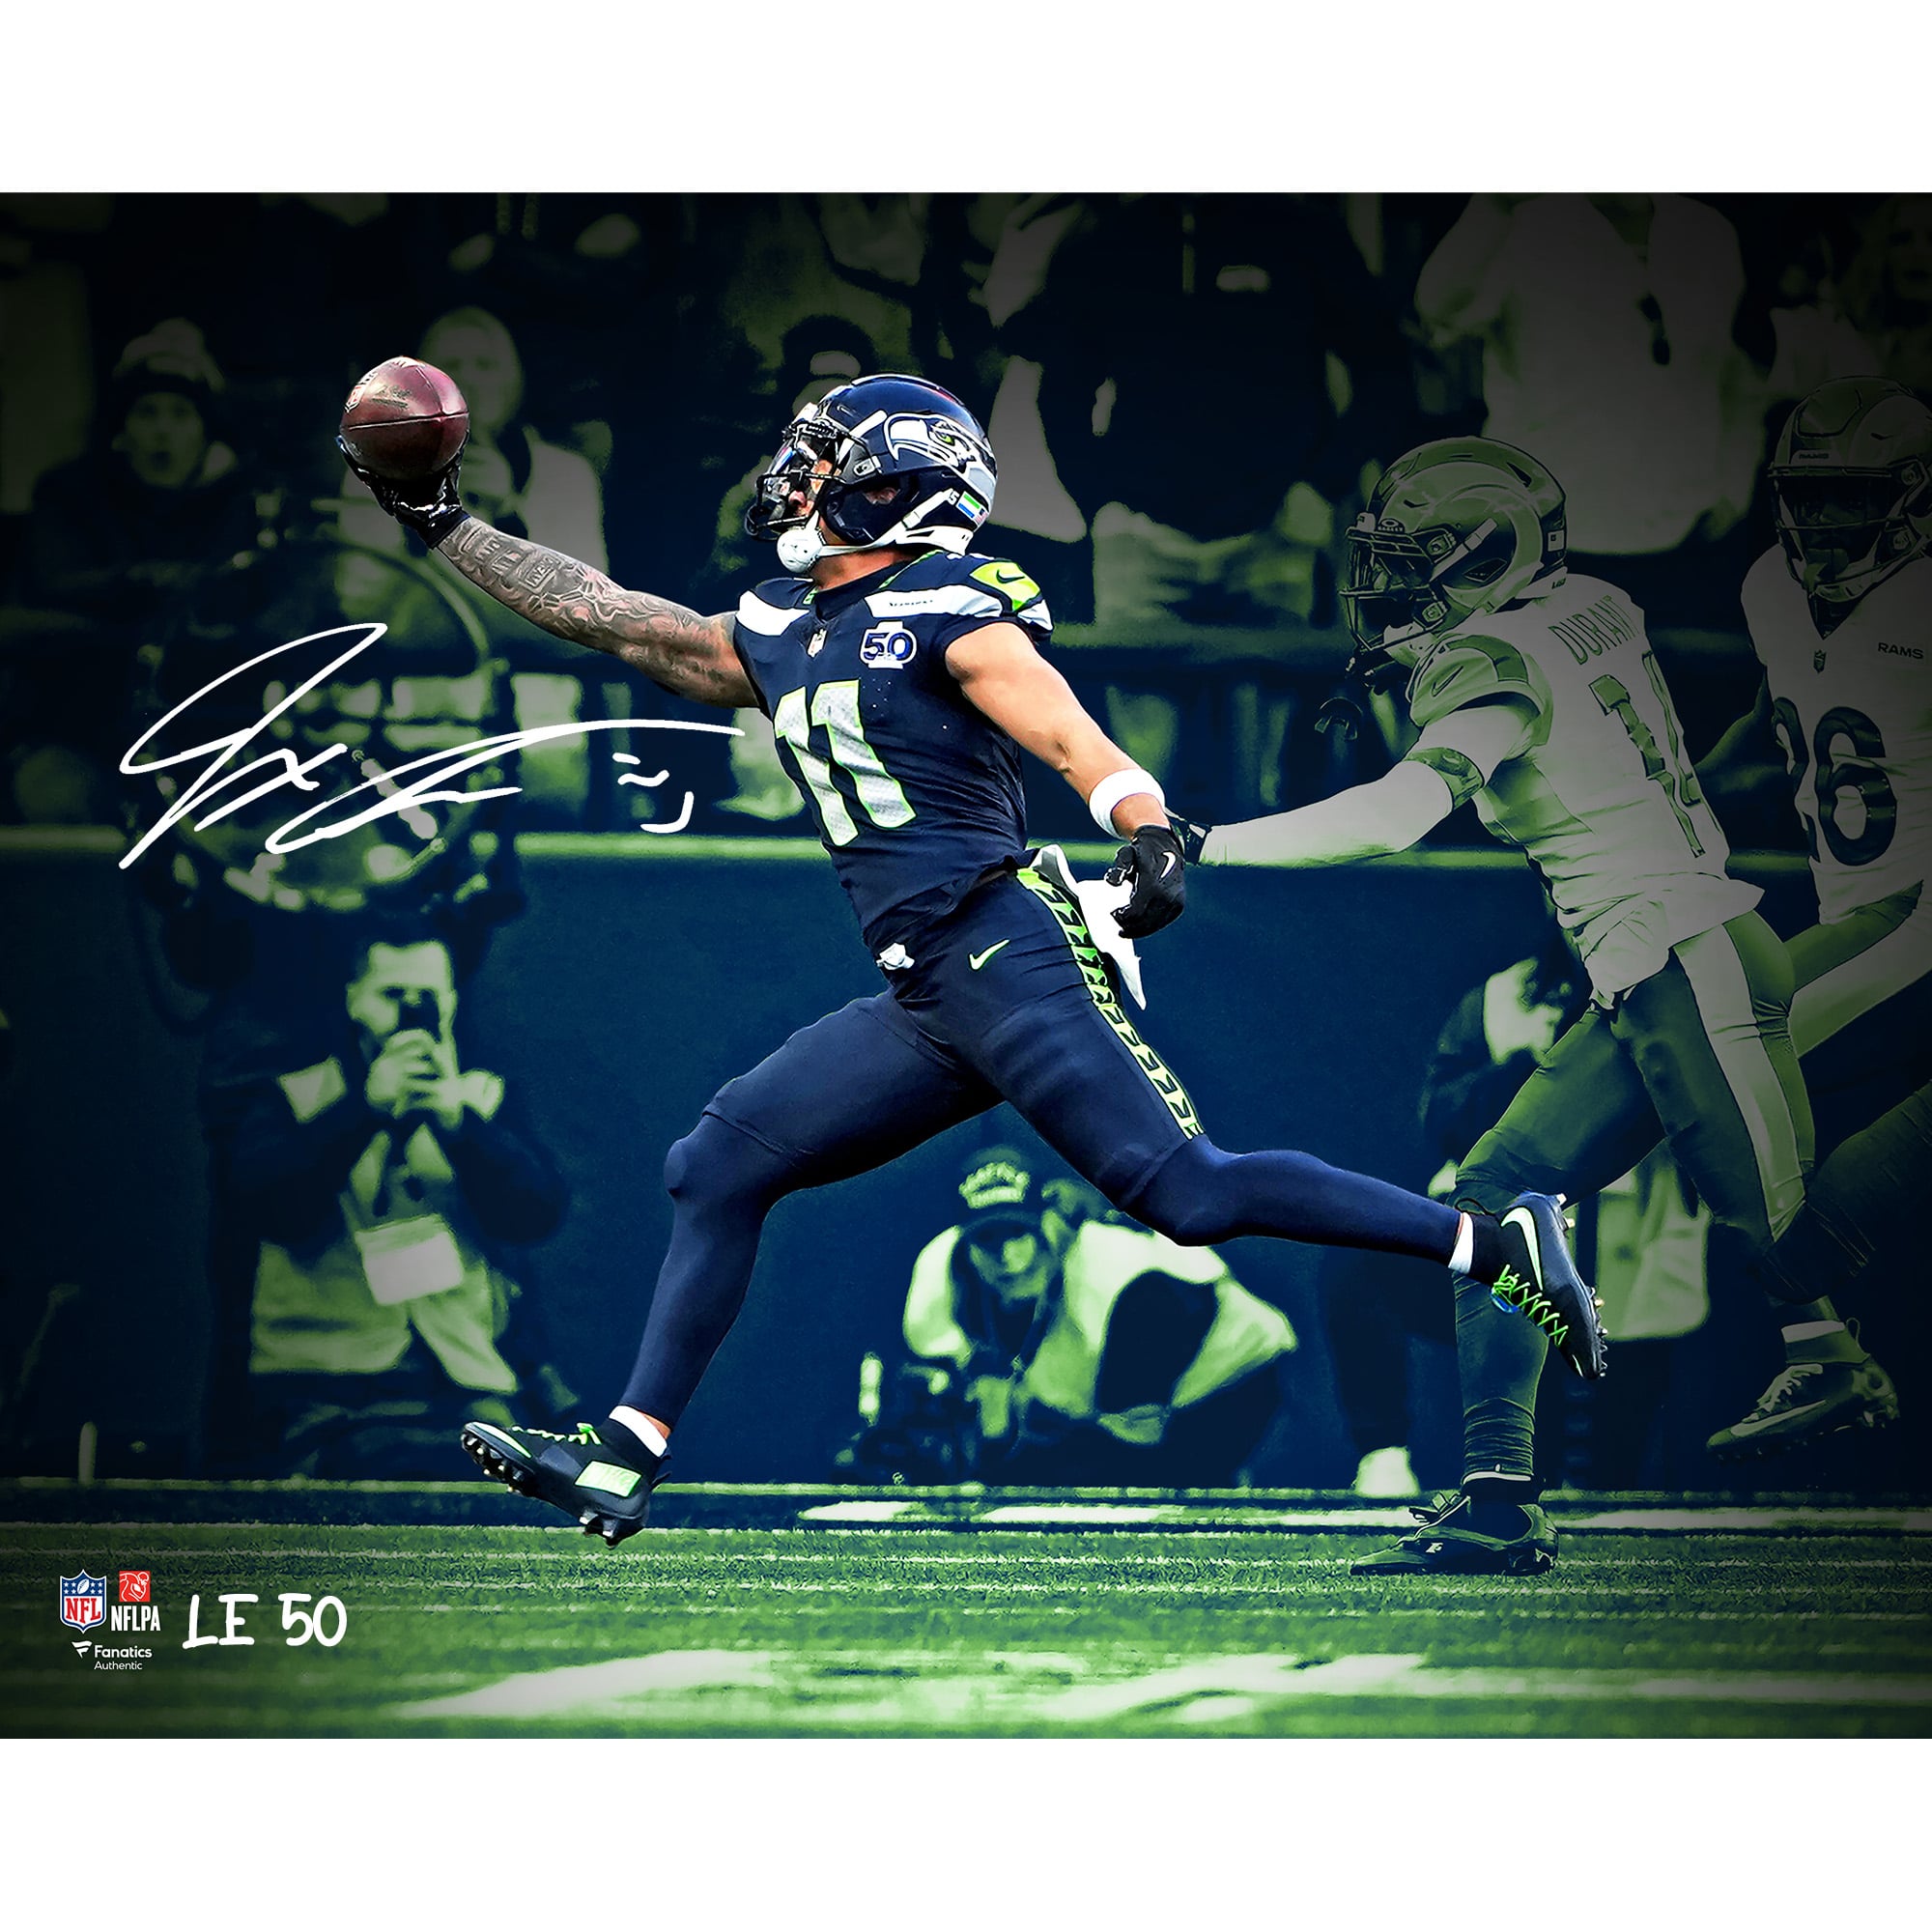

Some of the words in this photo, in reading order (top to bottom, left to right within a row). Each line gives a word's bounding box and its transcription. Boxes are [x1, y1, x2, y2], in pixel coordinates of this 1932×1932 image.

[863, 632, 913, 661] 50
[1877, 642, 1924, 660] RAMS
[774, 678, 917, 847] 11
